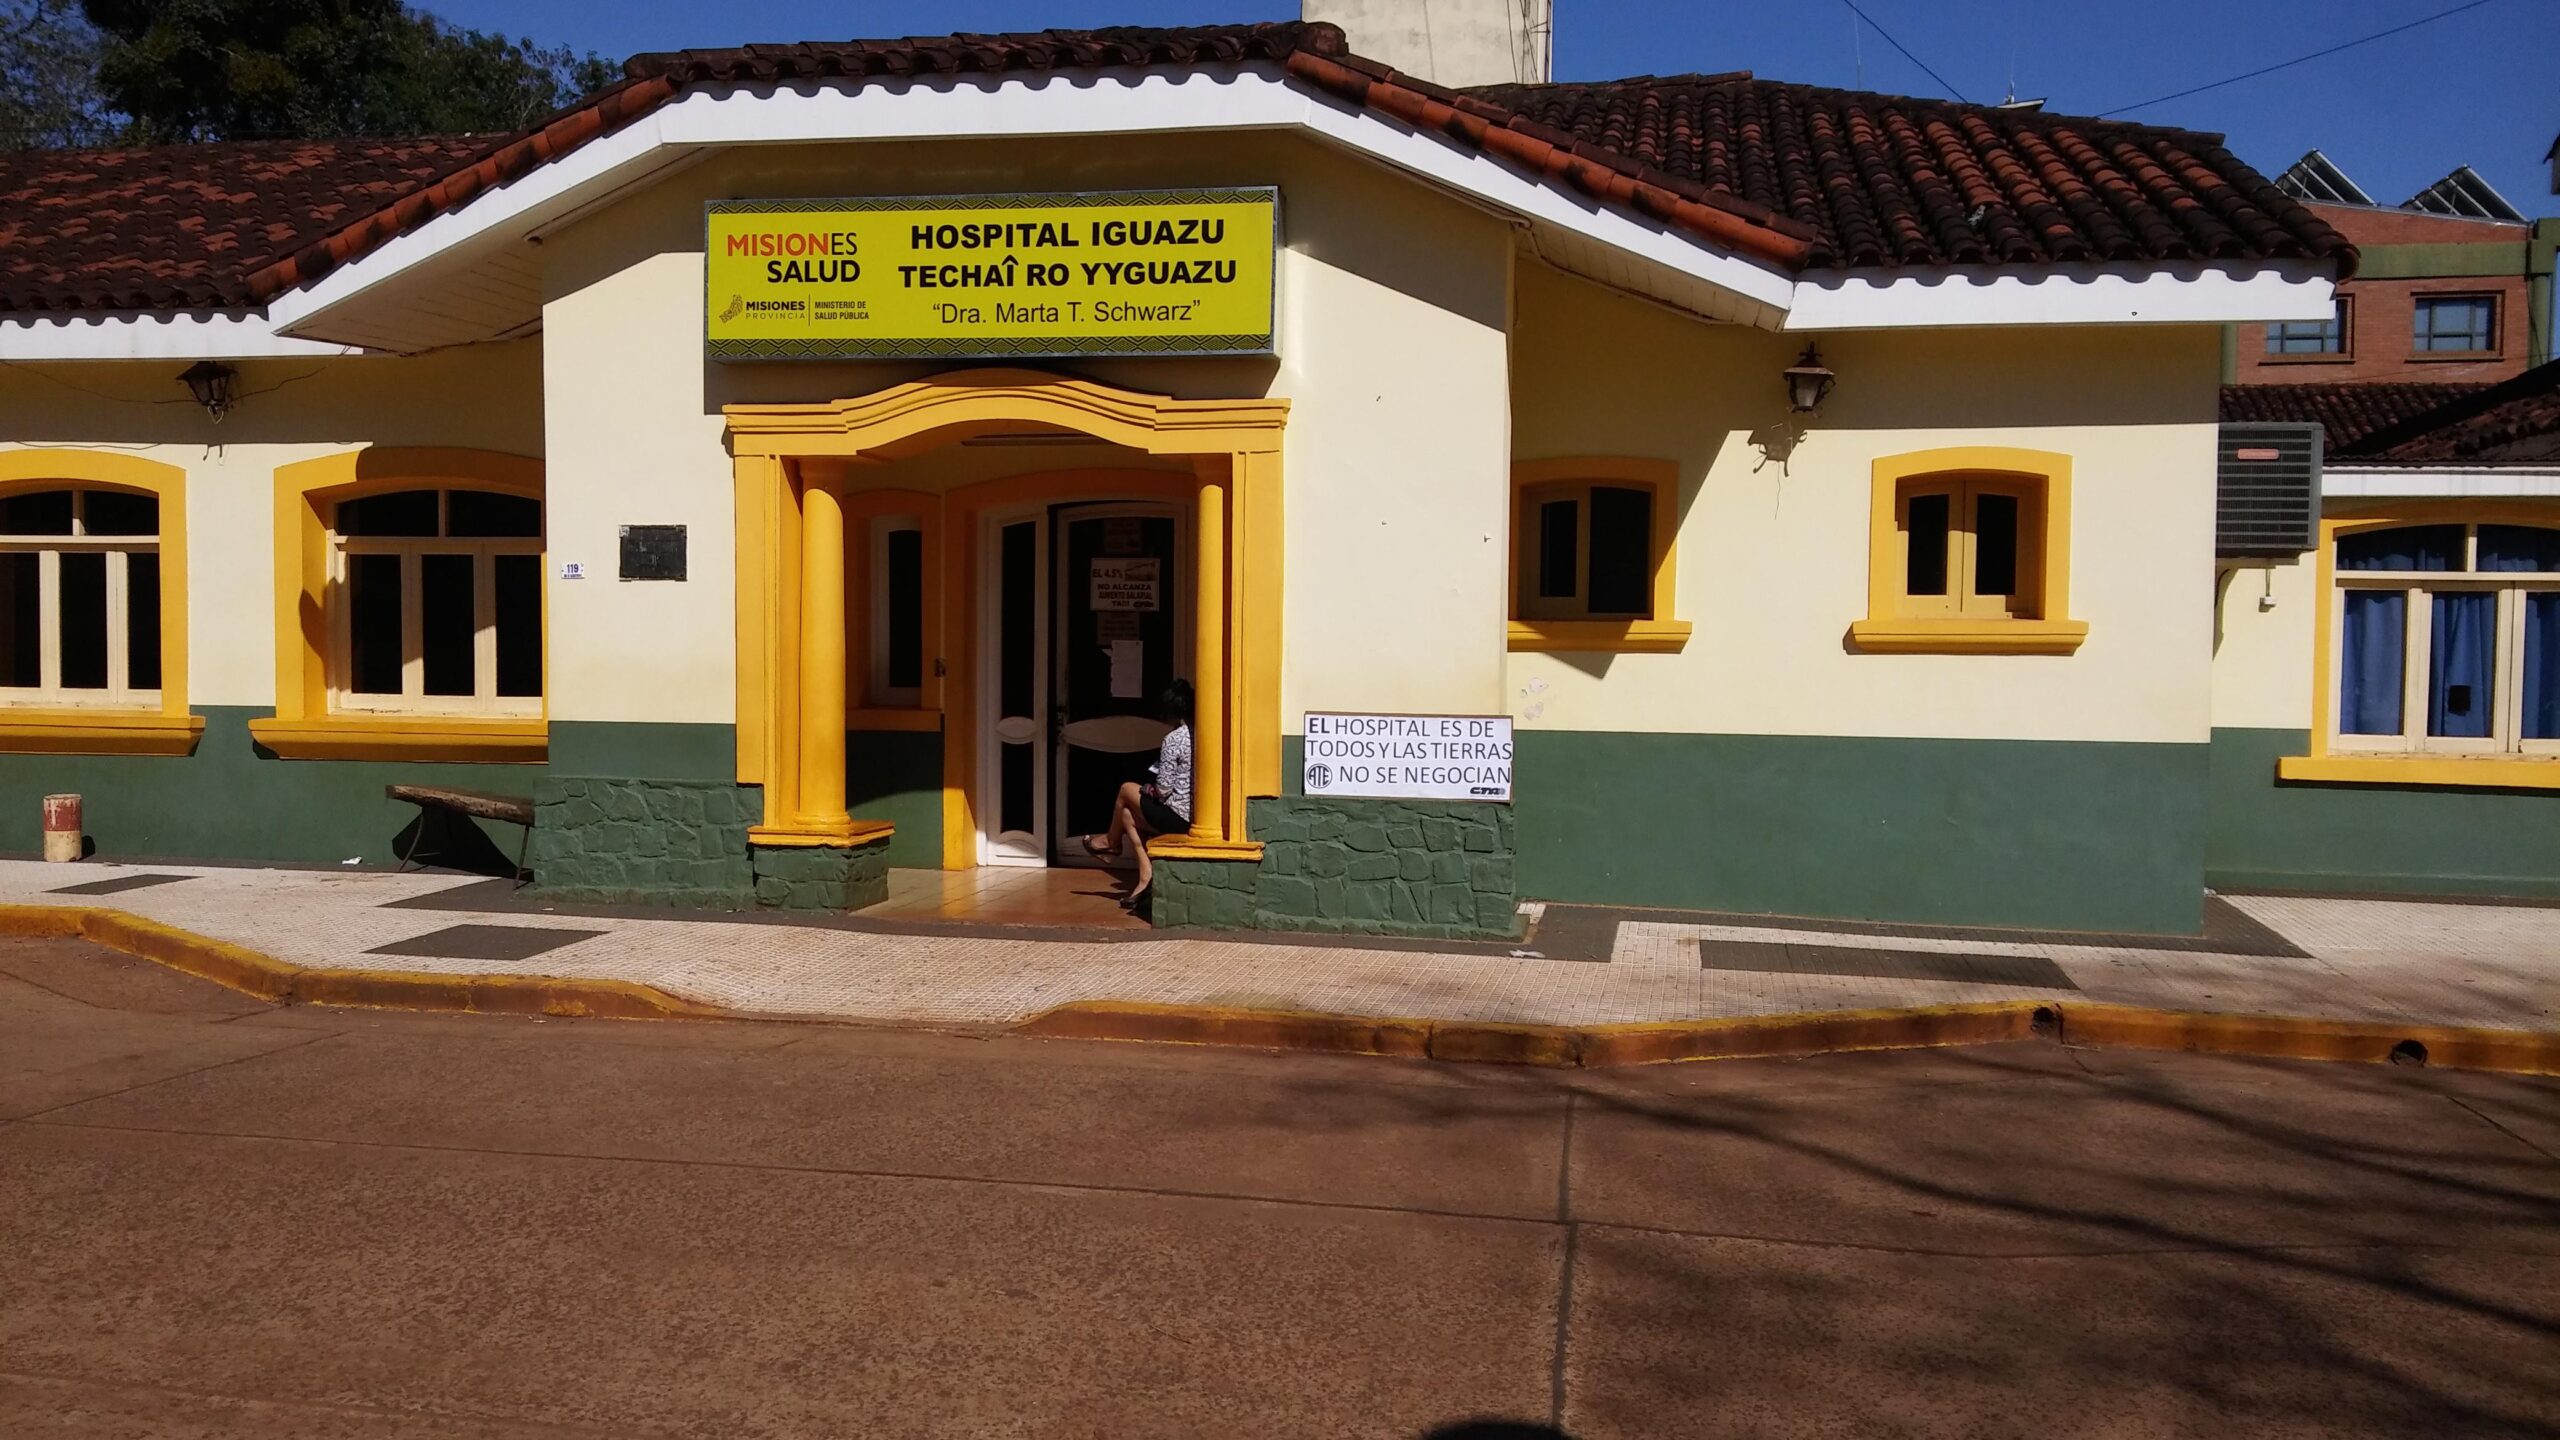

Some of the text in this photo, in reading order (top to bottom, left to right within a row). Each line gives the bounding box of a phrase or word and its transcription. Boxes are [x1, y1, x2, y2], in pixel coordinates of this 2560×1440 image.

[911, 219, 1225, 249] HOSPITAL IGUAZU
[727, 232, 858, 256] MISIONES
[767, 259, 861, 283] SALUD
[1026, 263, 1070, 287] RO
[1081, 260, 1237, 286] YYGUAZU
[746, 301, 806, 311] MISIONES
[814, 300, 867, 310] MINISTERIO DE
[814, 309, 870, 320] SALUD PÚBLICA
[996, 303, 1059, 323] Marta
[1067, 302, 1085, 322] T.
[745, 312, 806, 320] PROVINCIA
[567, 563, 579, 573] 119
[1093, 568, 1103, 578] EL
[1309, 717, 1495, 738] EL HOSPITAL ES DE
[1306, 740, 1513, 760] TODOS Y LAS TIERRAS
[1340, 766, 1511, 784] NO SE NEGOCIAN
